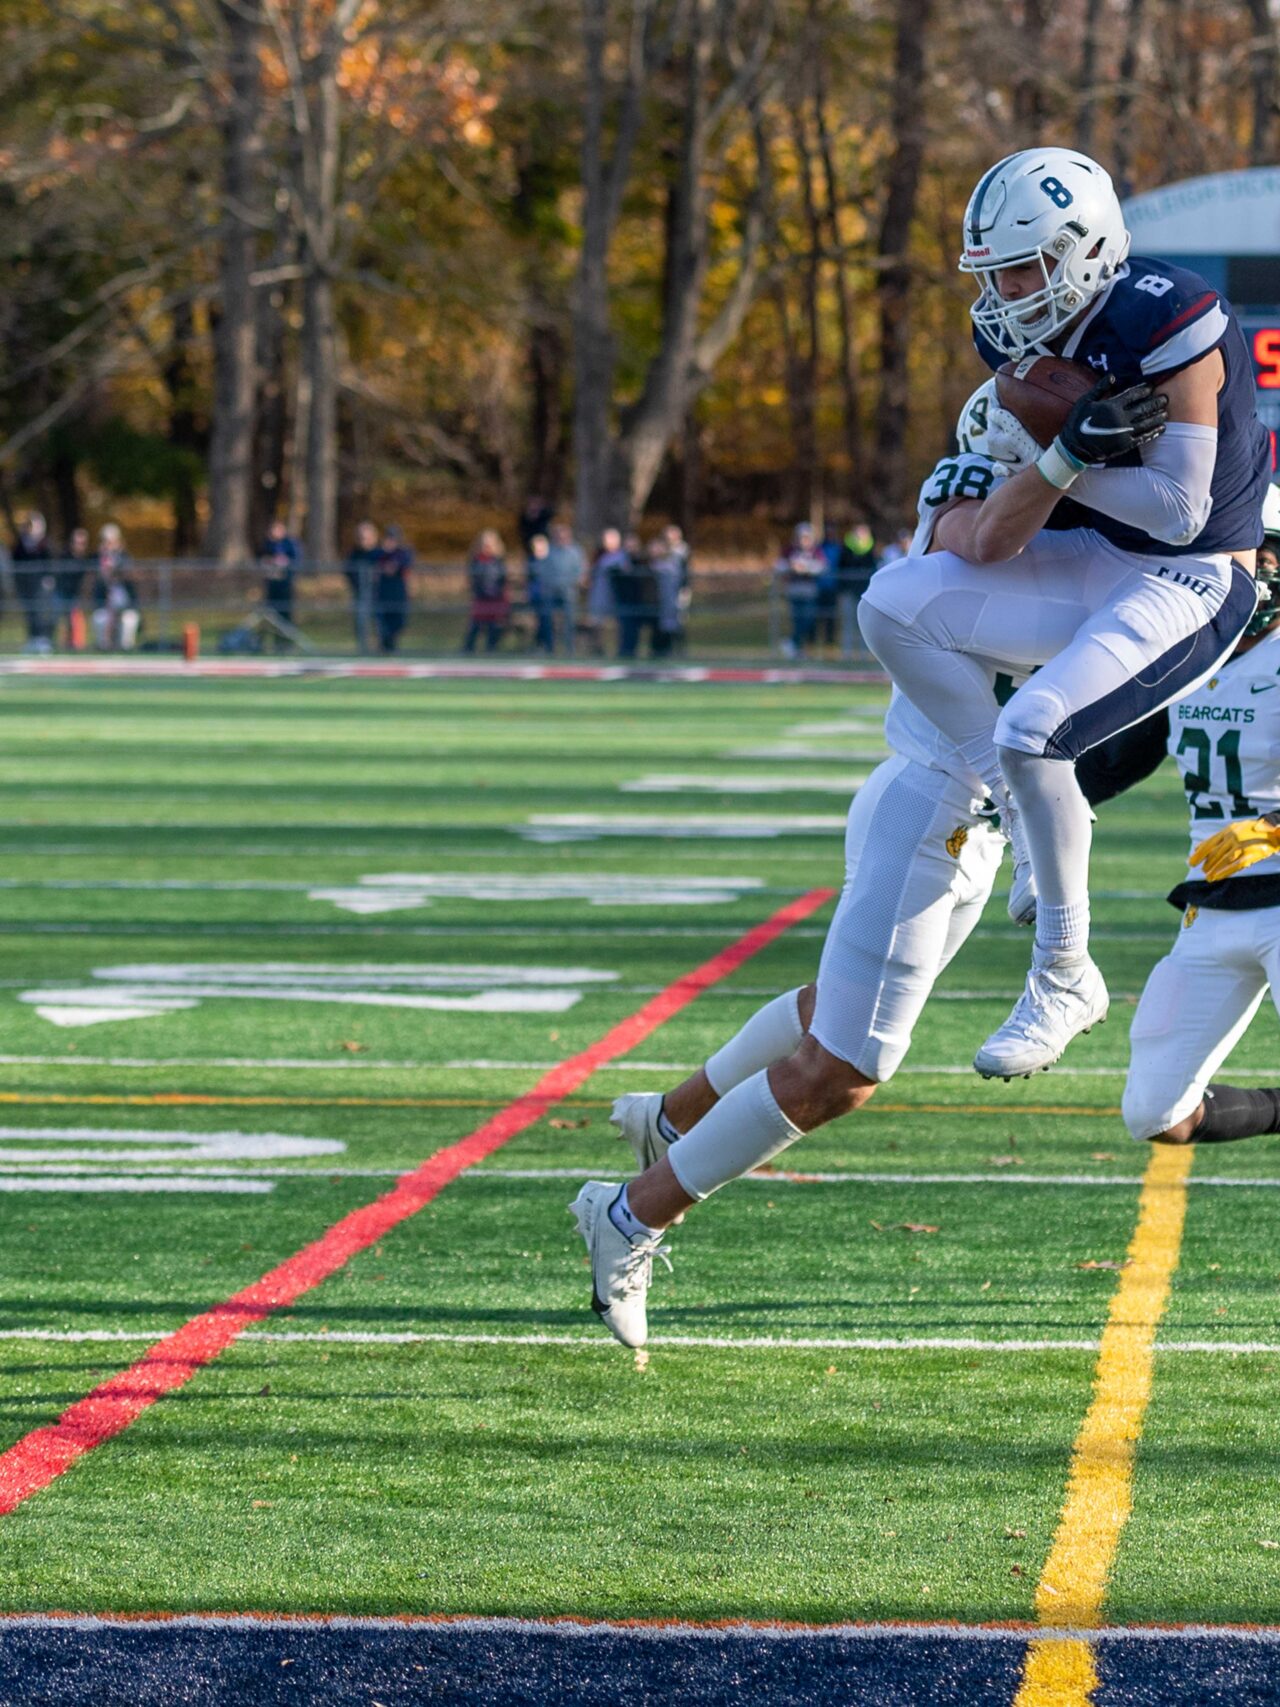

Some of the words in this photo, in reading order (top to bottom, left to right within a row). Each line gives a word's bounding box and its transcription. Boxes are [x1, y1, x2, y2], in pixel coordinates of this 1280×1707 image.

[1039, 175, 1074, 209] 8
[1134, 273, 1175, 298] 8
[924, 463, 995, 507] 38
[1178, 704, 1256, 723] BEARCATS
[1176, 727, 1259, 820] 21
